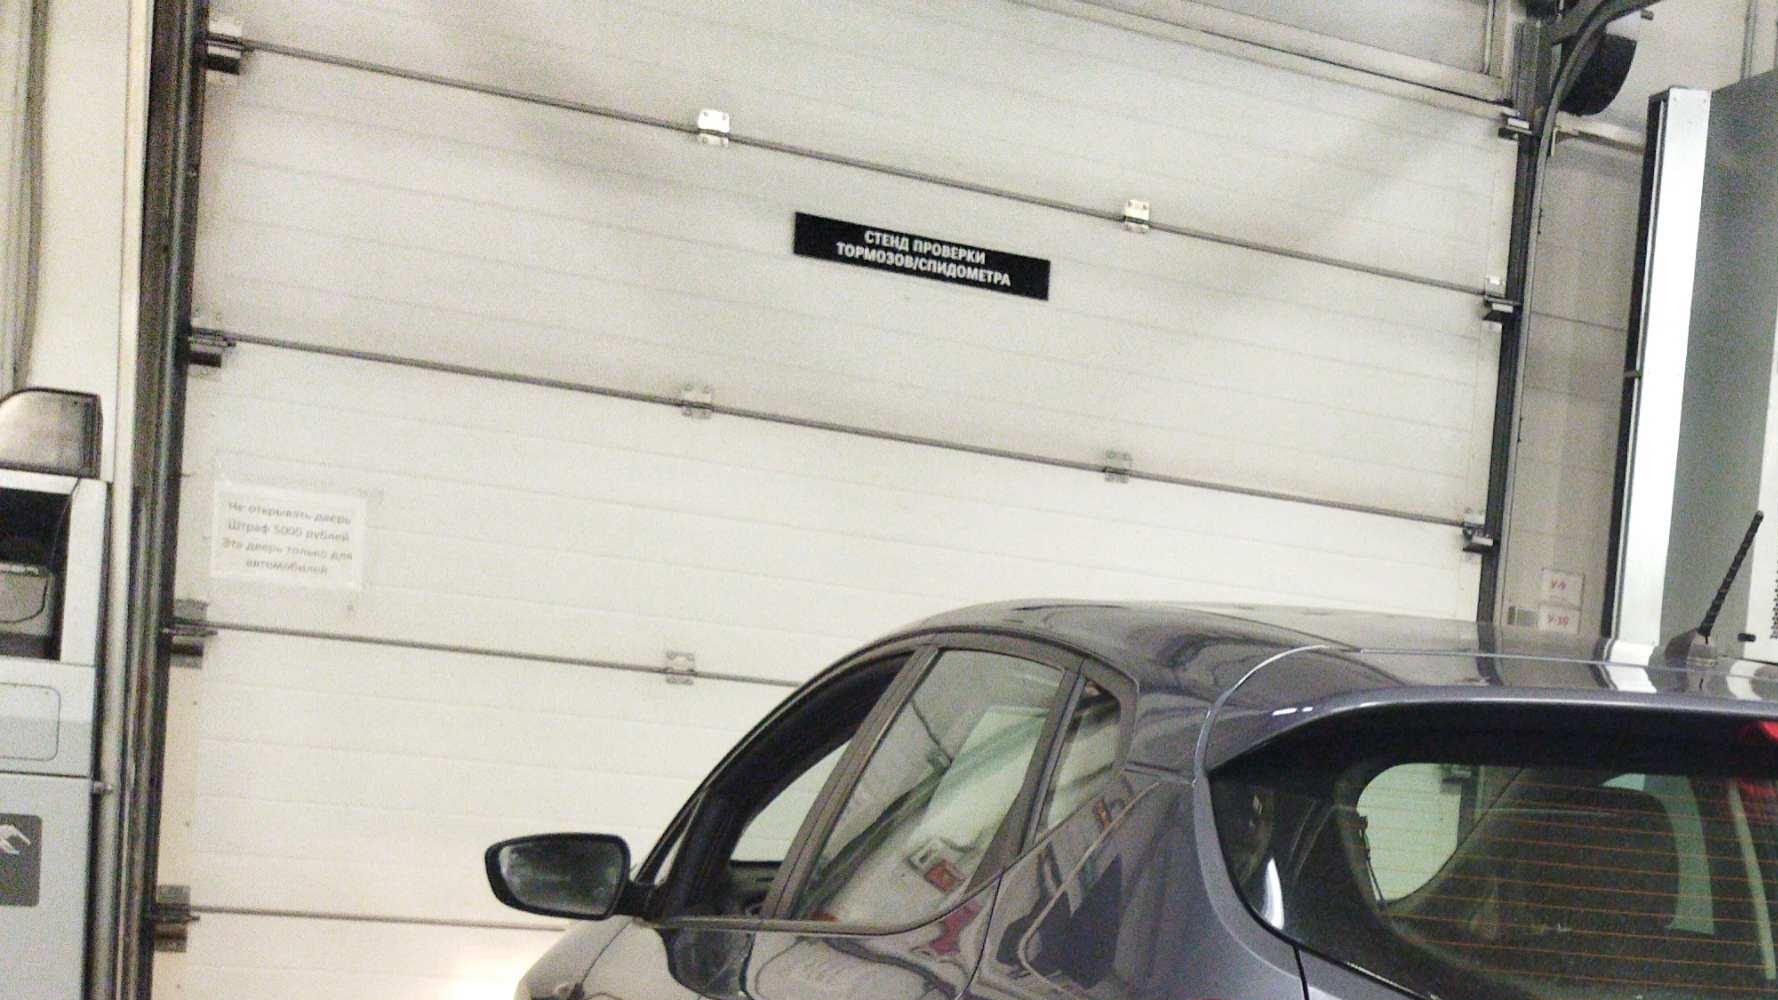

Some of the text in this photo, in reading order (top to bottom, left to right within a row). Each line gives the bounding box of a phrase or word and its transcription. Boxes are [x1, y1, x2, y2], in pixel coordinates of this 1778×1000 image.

[836, 241, 1011, 287] ТОРМОЗОВ/СПИДОМЕТРА
[864, 230, 986, 265] СТЕНД ПРОВЕРКИ
[227, 519, 350, 543] Штраф 5000 рублей
